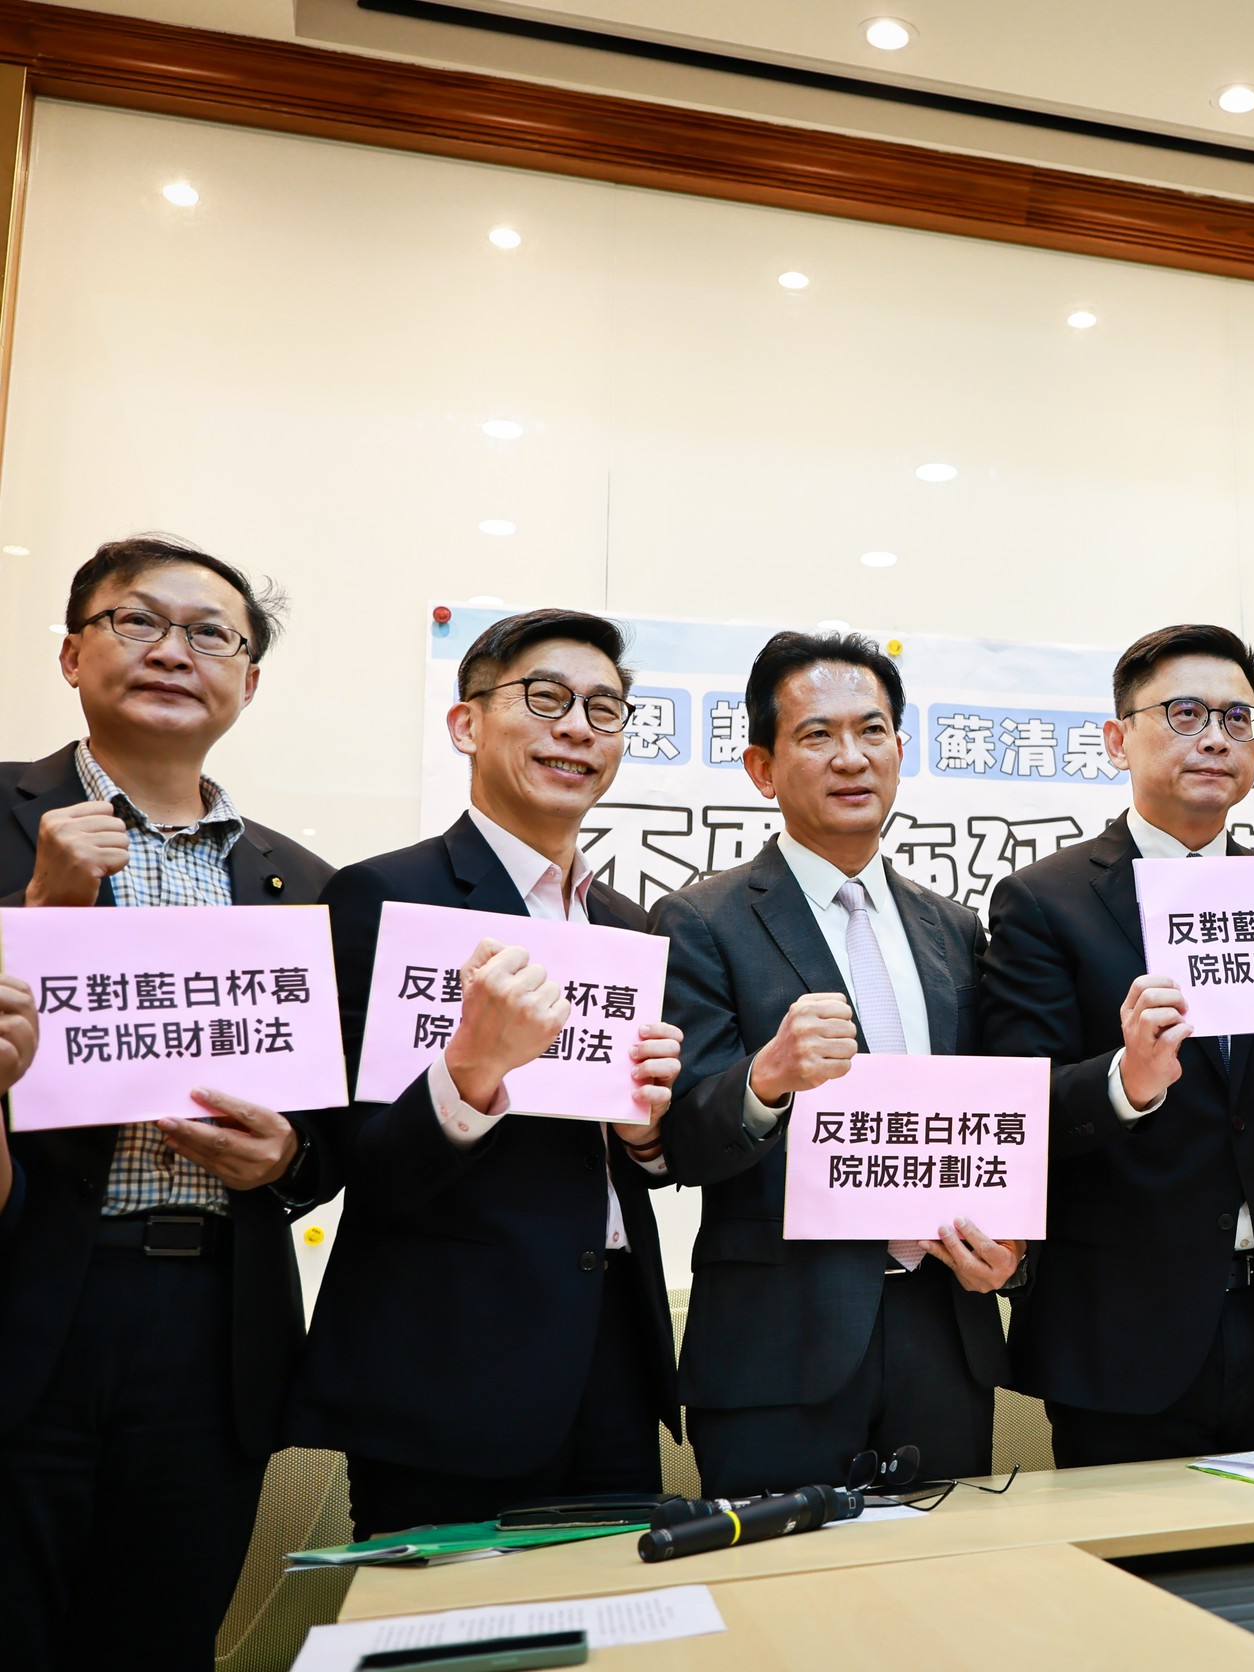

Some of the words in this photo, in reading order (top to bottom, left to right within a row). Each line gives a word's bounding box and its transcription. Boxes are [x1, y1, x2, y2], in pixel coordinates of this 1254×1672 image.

[935, 713, 1119, 780] 蘇清泉
[38, 968, 310, 1014] 反對藍白杯葛
[66, 1017, 293, 1064] 院版財劃法
[812, 1111, 1026, 1145] 反對藍白杯葛
[829, 1155, 1007, 1188] 院版財劃法
